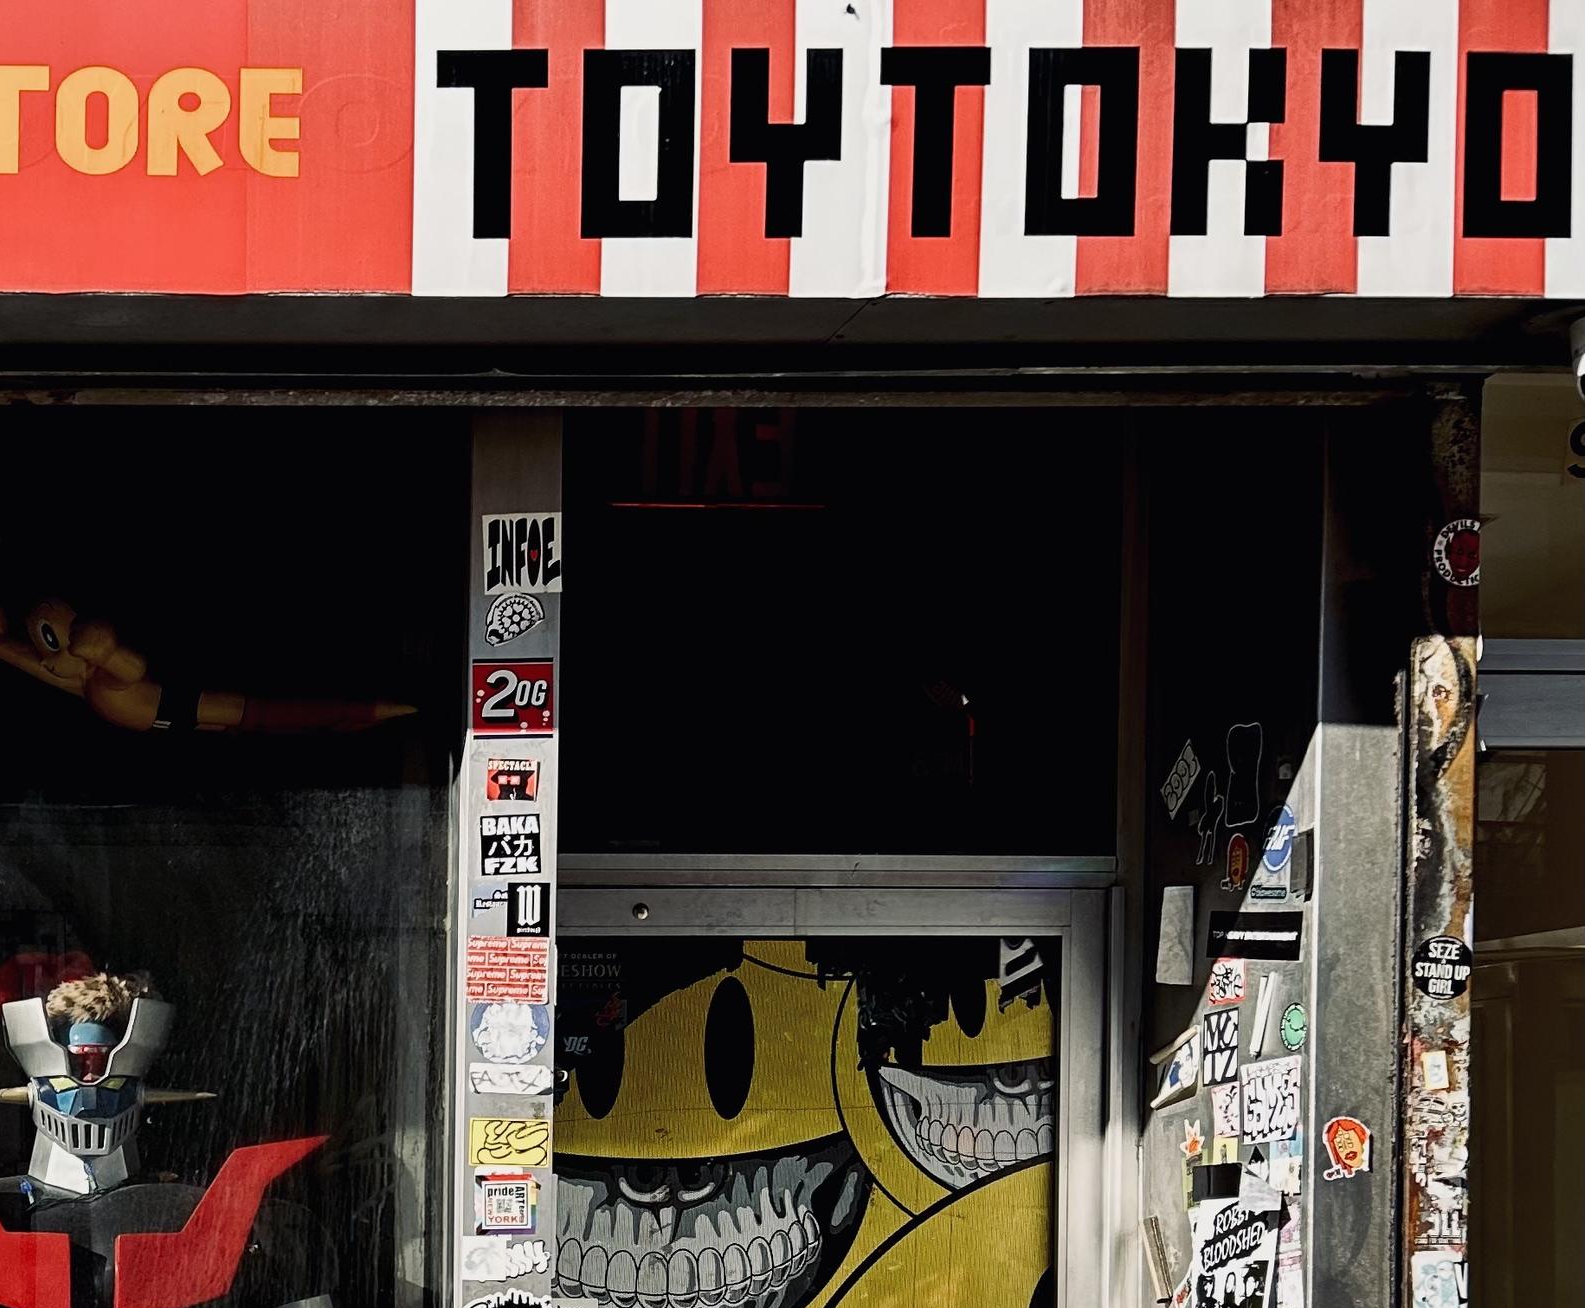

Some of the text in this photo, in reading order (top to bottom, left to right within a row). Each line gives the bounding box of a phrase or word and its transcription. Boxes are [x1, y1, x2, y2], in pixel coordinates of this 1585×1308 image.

[481, 816, 540, 836] BAKA
[488, 835, 534, 857] バカ
[488, 954, 530, 964] Supreme
[1428, 942, 1460, 960] SEZE
[1415, 961, 1471, 981] STAND UP
[486, 984, 529, 995] Supreme
[1428, 978, 1454, 995] GIRL
[487, 1187, 514, 1198] pride
[487, 1216, 519, 1224] YORK
[1202, 1221, 1266, 1270] BLOODSHED
